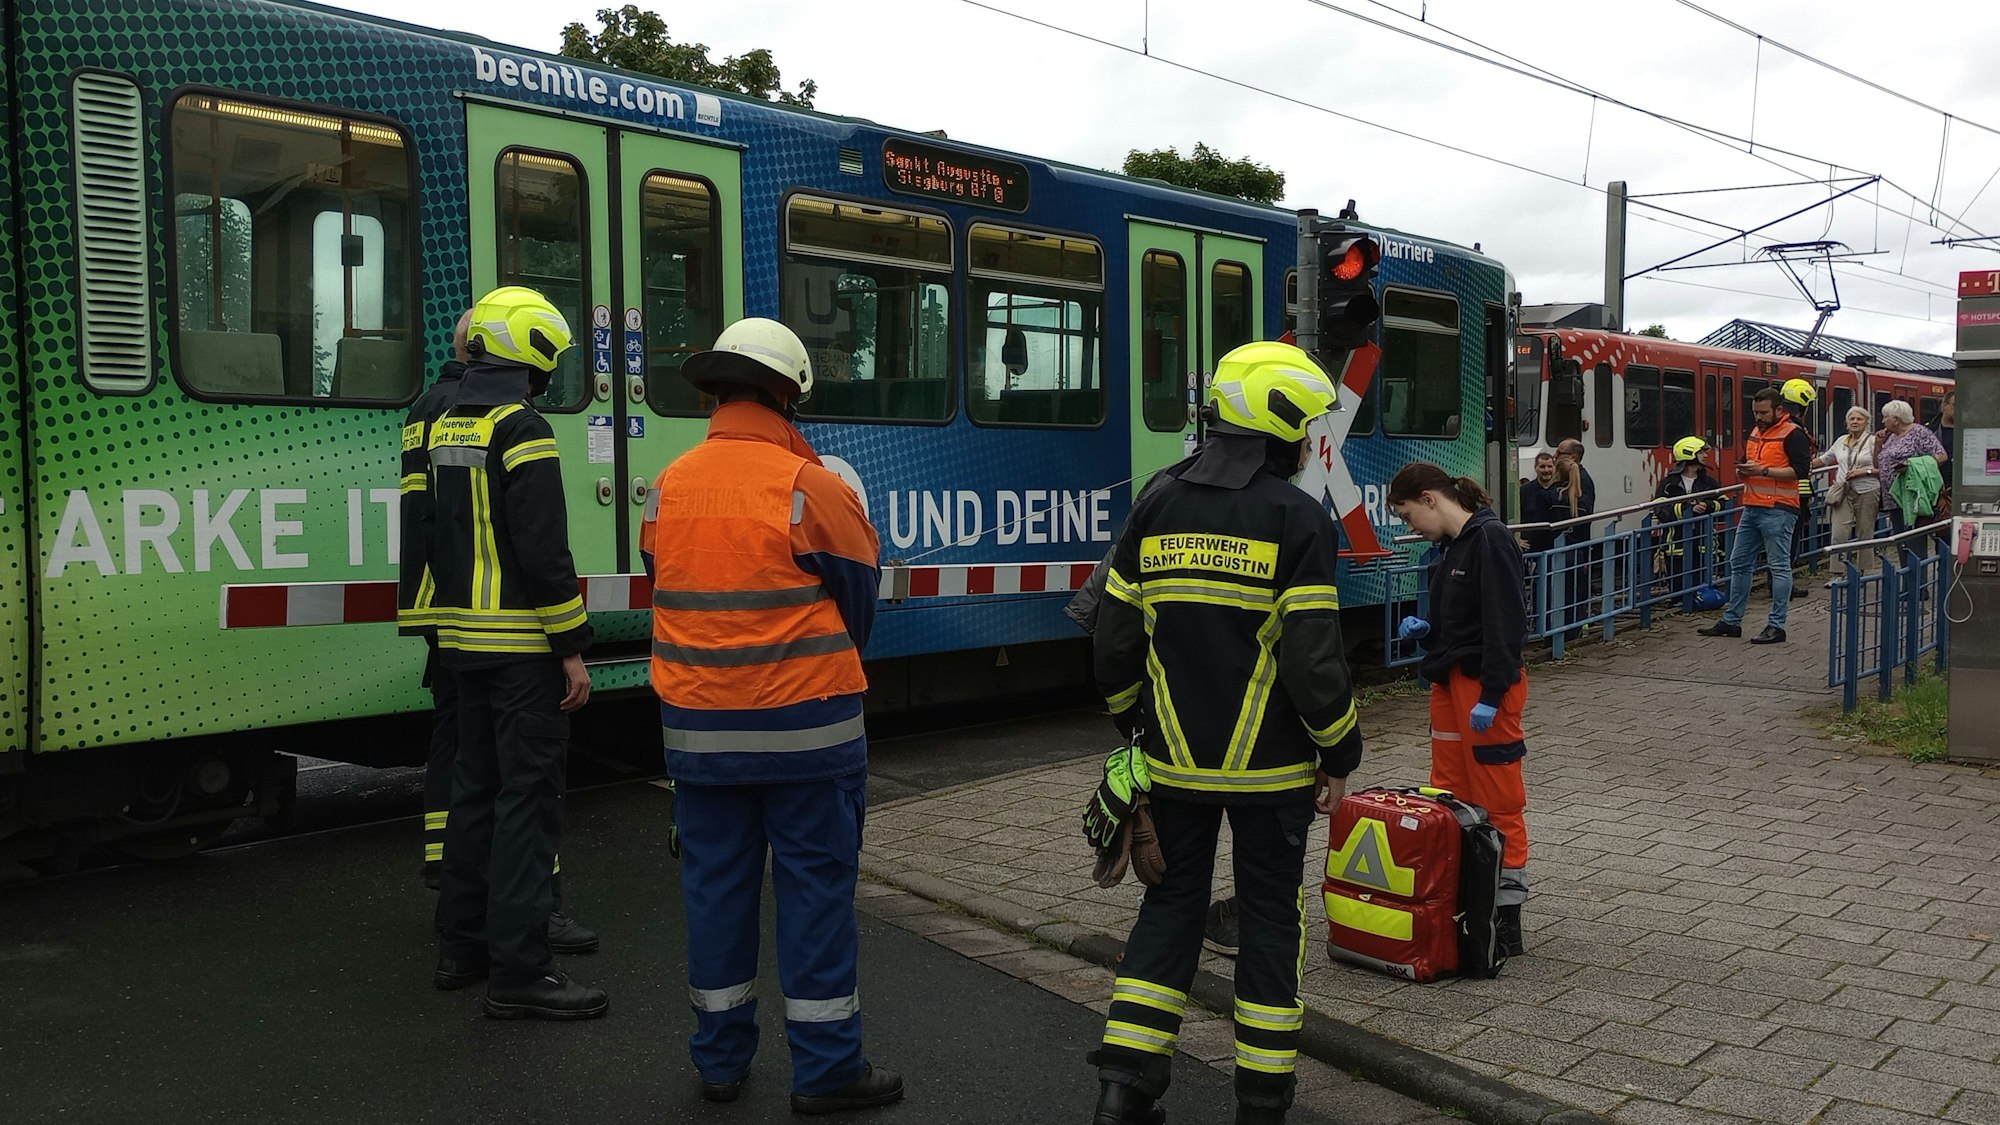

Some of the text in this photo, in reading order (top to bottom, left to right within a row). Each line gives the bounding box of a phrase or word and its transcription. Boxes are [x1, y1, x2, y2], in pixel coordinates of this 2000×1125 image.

[471, 47, 684, 119] bechtle.com
[697, 113, 720, 123] BECHTLE
[885, 151, 930, 173] Sankt
[937, 160, 1000, 186] Augustin
[898, 169, 964, 197] Siegburg
[45, 489, 309, 578] ARKE
[889, 490, 1112, 549] UND DEINE
[1160, 537, 1249, 556] FEUERWEHR
[1143, 553, 1270, 575] SANKT AUGUSTIN
